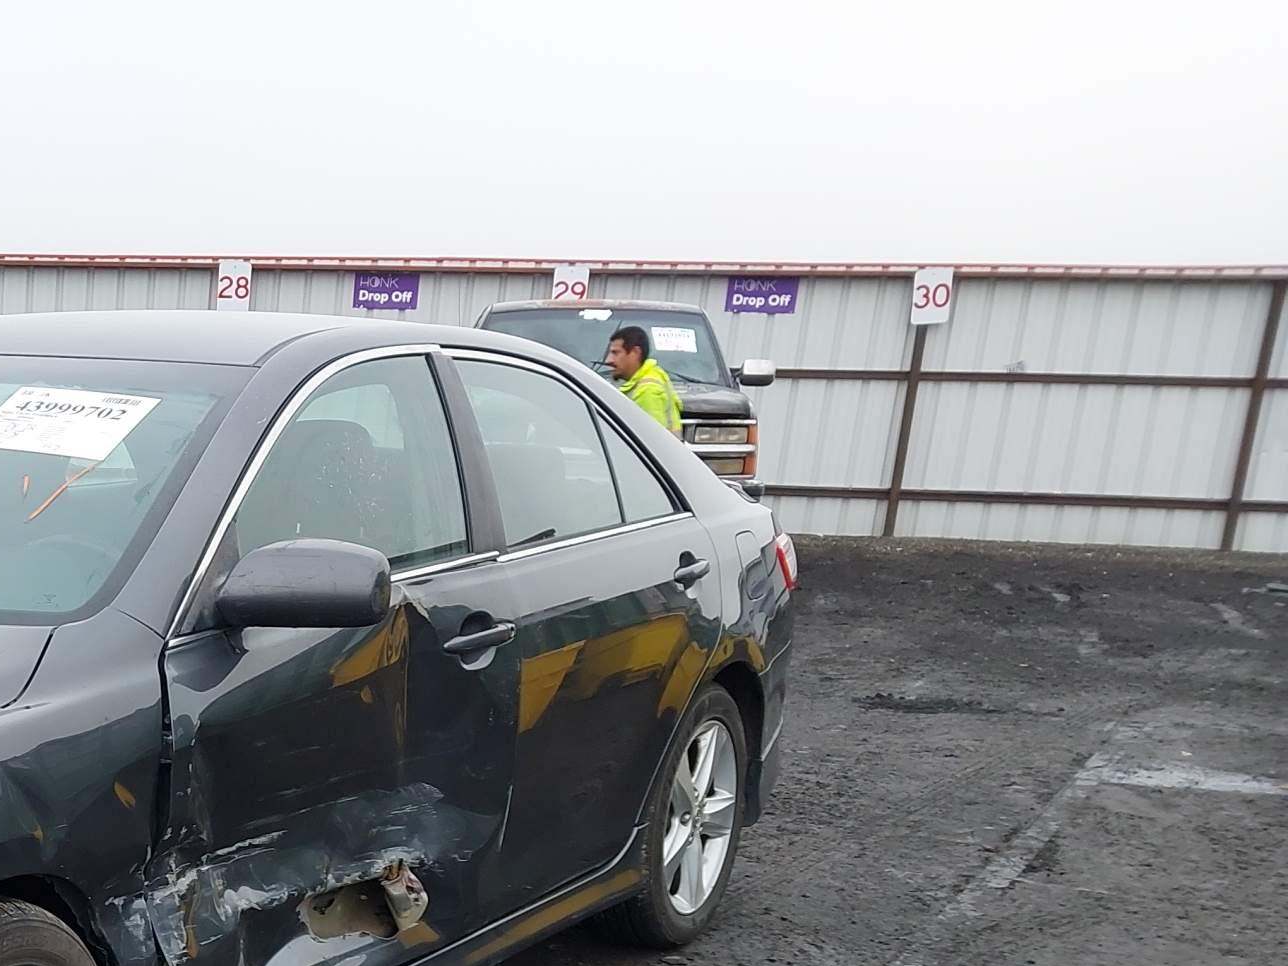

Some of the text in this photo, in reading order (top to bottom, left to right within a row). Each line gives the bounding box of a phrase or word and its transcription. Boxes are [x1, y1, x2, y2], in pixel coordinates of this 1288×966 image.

[218, 276, 249, 299] 28
[359, 276, 399, 288] HONK
[734, 279, 776, 291] HONK
[358, 290, 413, 304] Drop Off
[554, 281, 586, 300] 29
[914, 284, 950, 308] 30
[732, 294, 791, 308] Drop Off
[16, 400, 128, 420] 43999702
